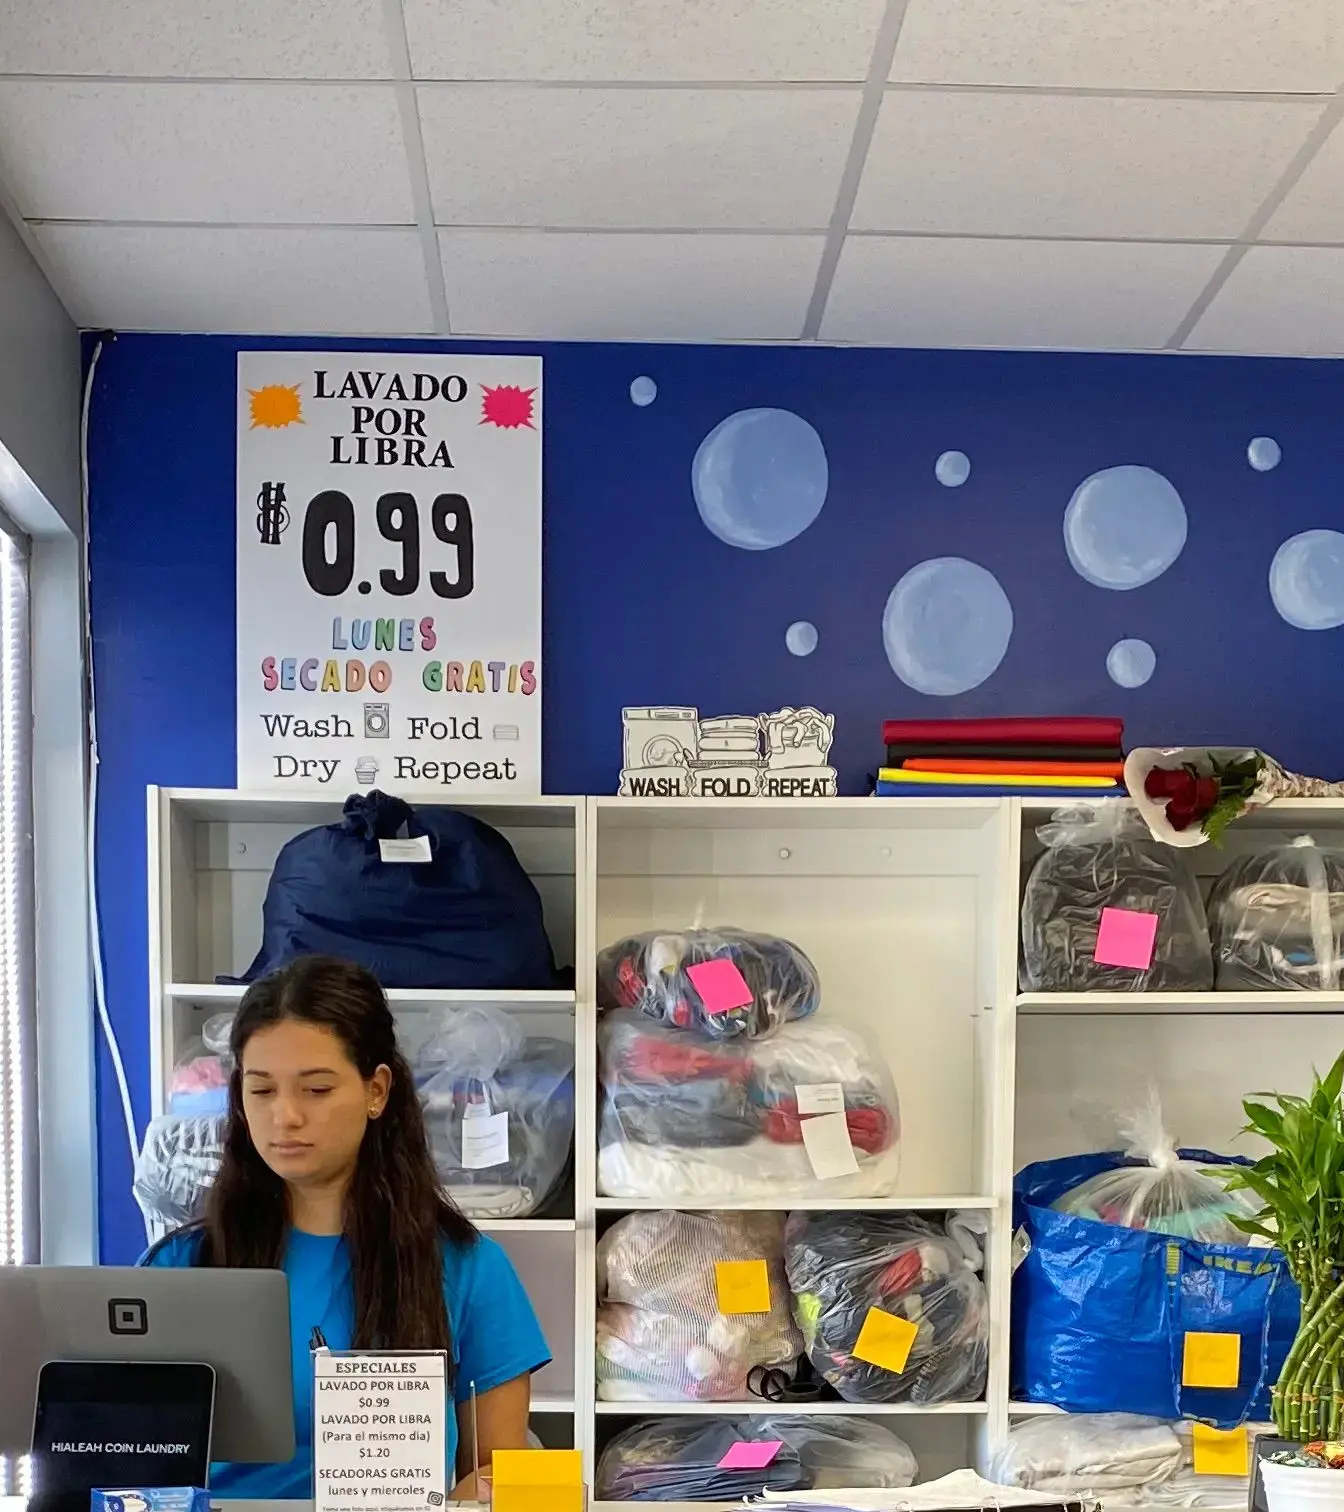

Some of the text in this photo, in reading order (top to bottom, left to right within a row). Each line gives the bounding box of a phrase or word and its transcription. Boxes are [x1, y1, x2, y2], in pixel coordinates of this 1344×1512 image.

[314, 371, 467, 402] LAVADO
[351, 407, 427, 437] POR
[330, 436, 455, 468] LIBRA
[333, 617, 437, 650] LUNES
[262, 657, 537, 695] SECADO GRATIS
[260, 714, 482, 740] Wash Fold
[274, 755, 516, 786] Dry Repeat
[629, 778, 829, 797] WASH FOLD REPEAT
[1203, 1256, 1278, 1273] IKEA
[336, 1363, 416, 1373] ESPECIALES
[320, 1381, 429, 1391] LAVADO POR LIBRA
[359, 1397, 389, 1408] $0.99
[322, 1415, 431, 1425] LAVADO POR LIBRA
[323, 1431, 353, 1442] (Para
[356, 1431, 365, 1441] el
[368, 1431, 406, 1441] mismo
[51, 1442, 190, 1454] HIALEAH COIN LAUNDRY
[359, 1448, 390, 1458] $1.20
[320, 1469, 430, 1479] SECADORAS GRATIS
[329, 1485, 358, 1495] lunes
[362, 1487, 368, 1497] y
